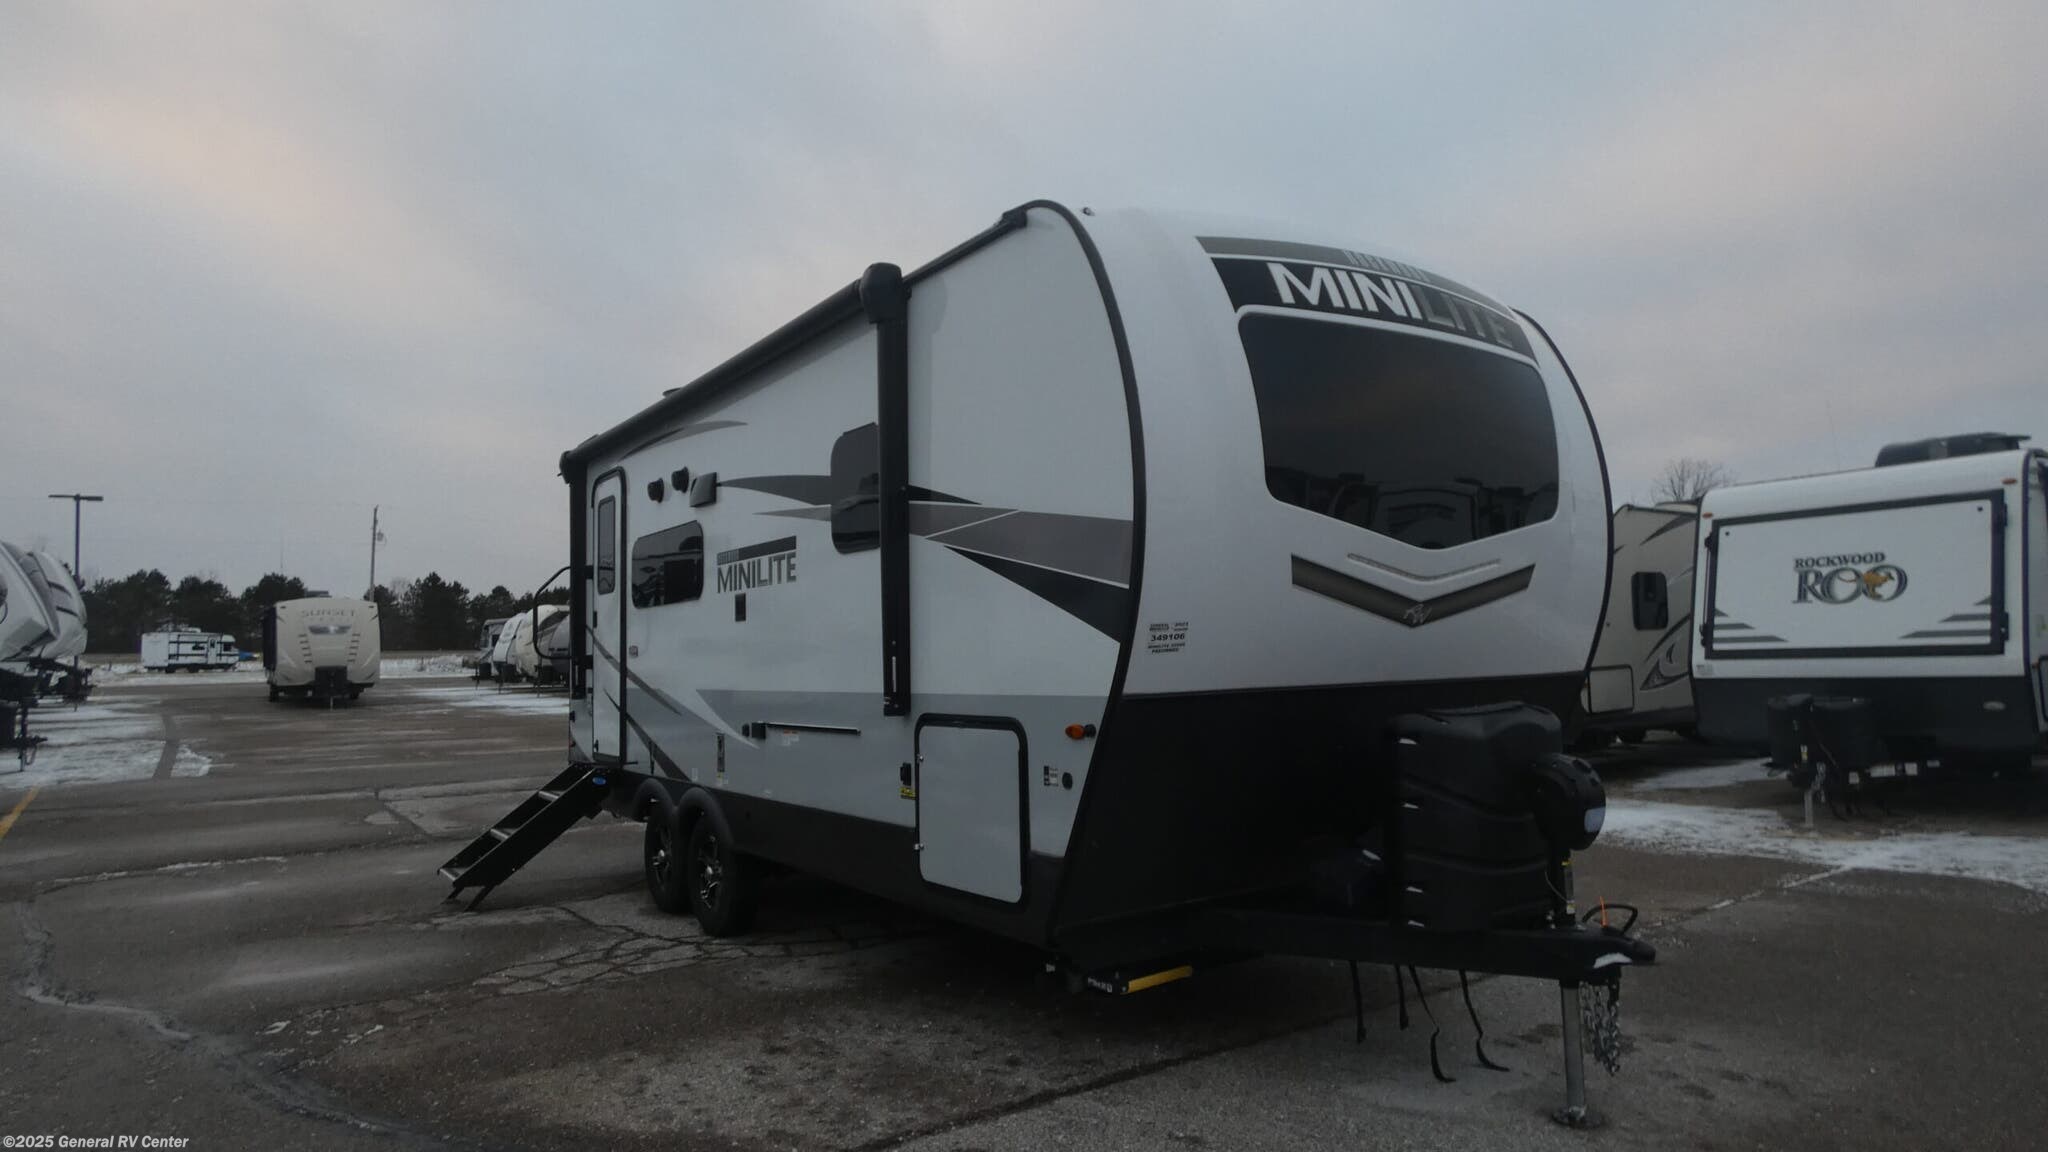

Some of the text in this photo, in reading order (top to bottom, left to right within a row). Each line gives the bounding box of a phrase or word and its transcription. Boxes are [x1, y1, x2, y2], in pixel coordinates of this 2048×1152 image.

[717, 551, 797, 594] MINILITE
[1795, 551, 1887, 569] ROCKWOOD
[1792, 564, 1908, 605] ROO
[301, 608, 355, 617] SUNSET
